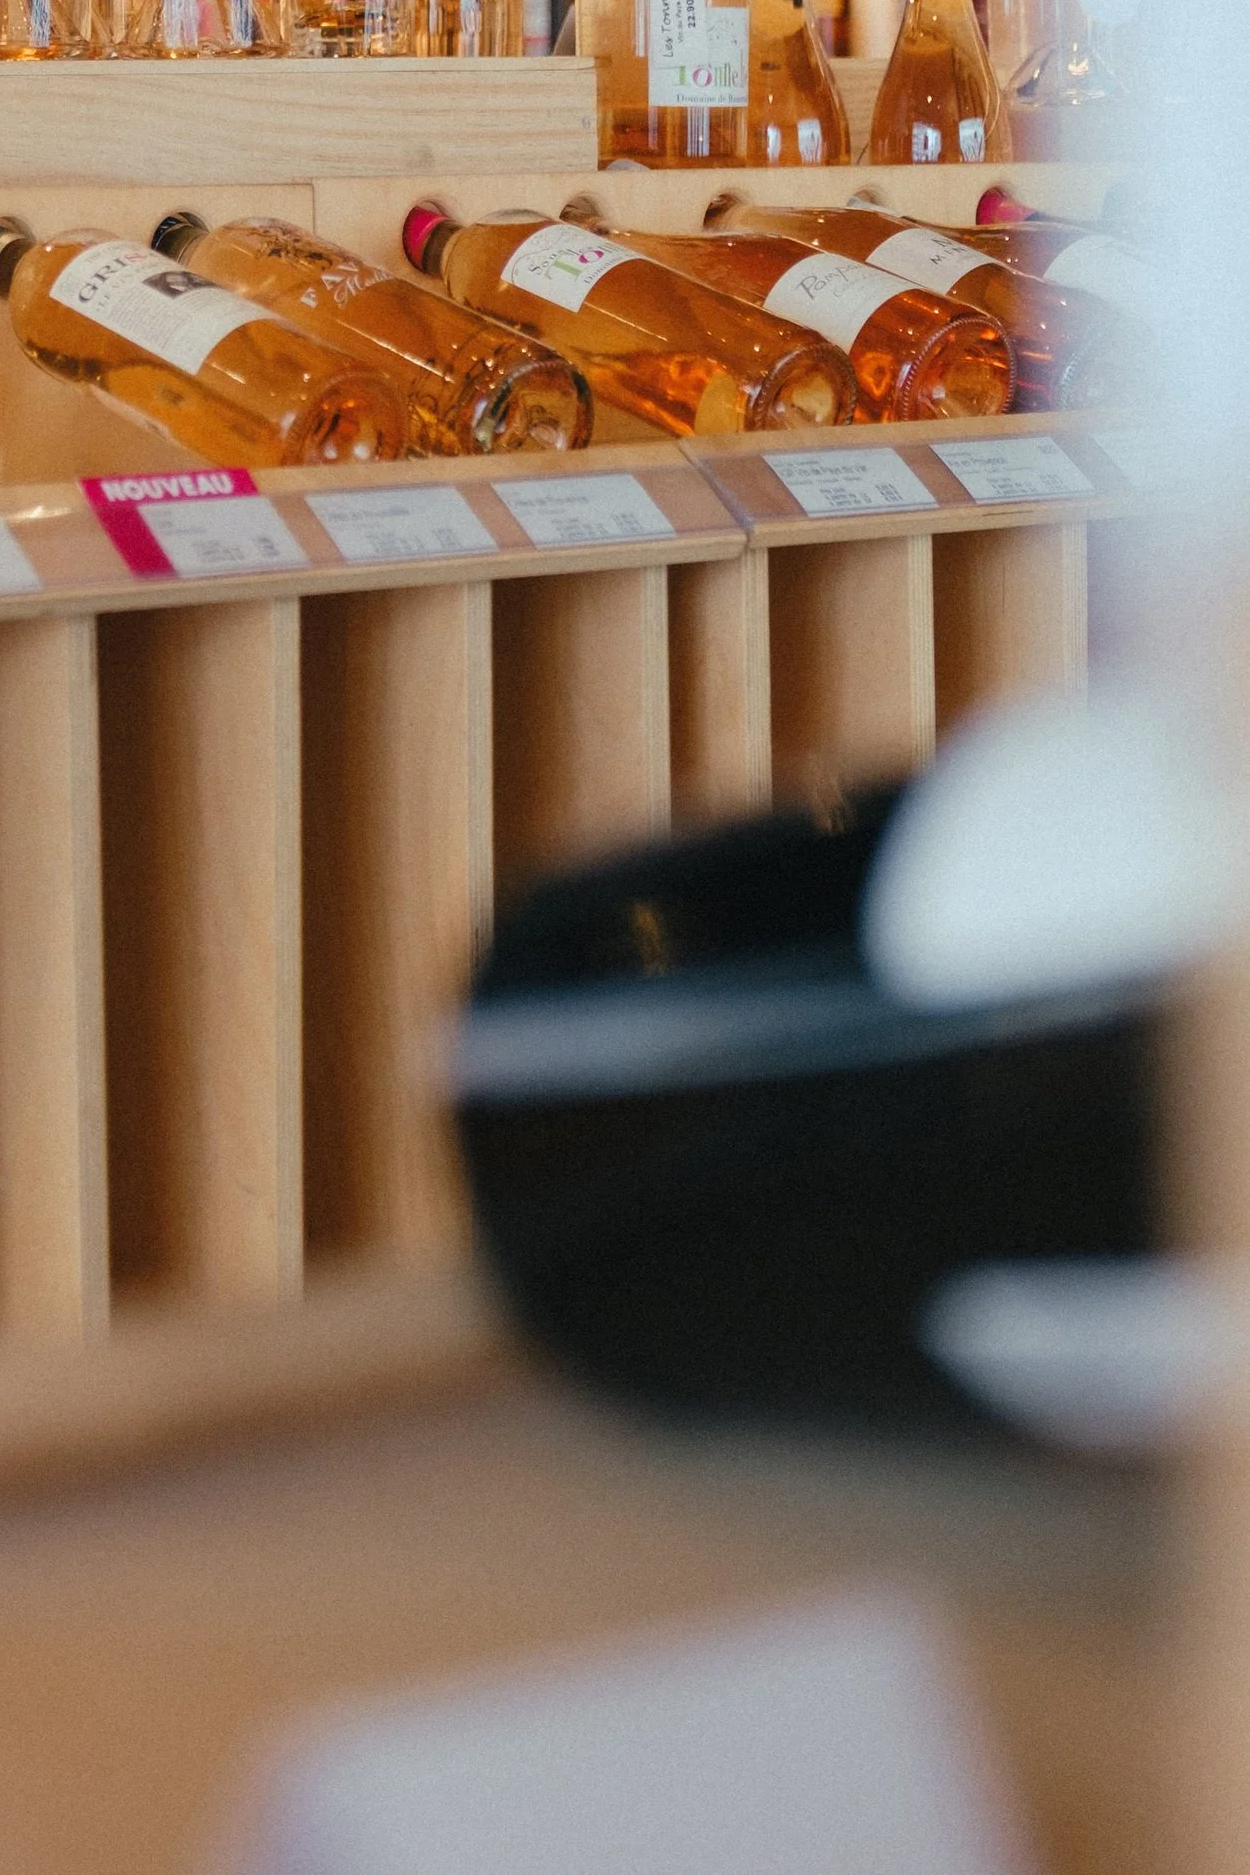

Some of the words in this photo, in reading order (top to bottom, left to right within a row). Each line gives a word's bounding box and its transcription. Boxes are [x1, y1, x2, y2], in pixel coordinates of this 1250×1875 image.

[662, 37, 674, 58] Les
[676, 93, 716, 103] Domaine
[101, 472, 235, 502] NOUVEAU
